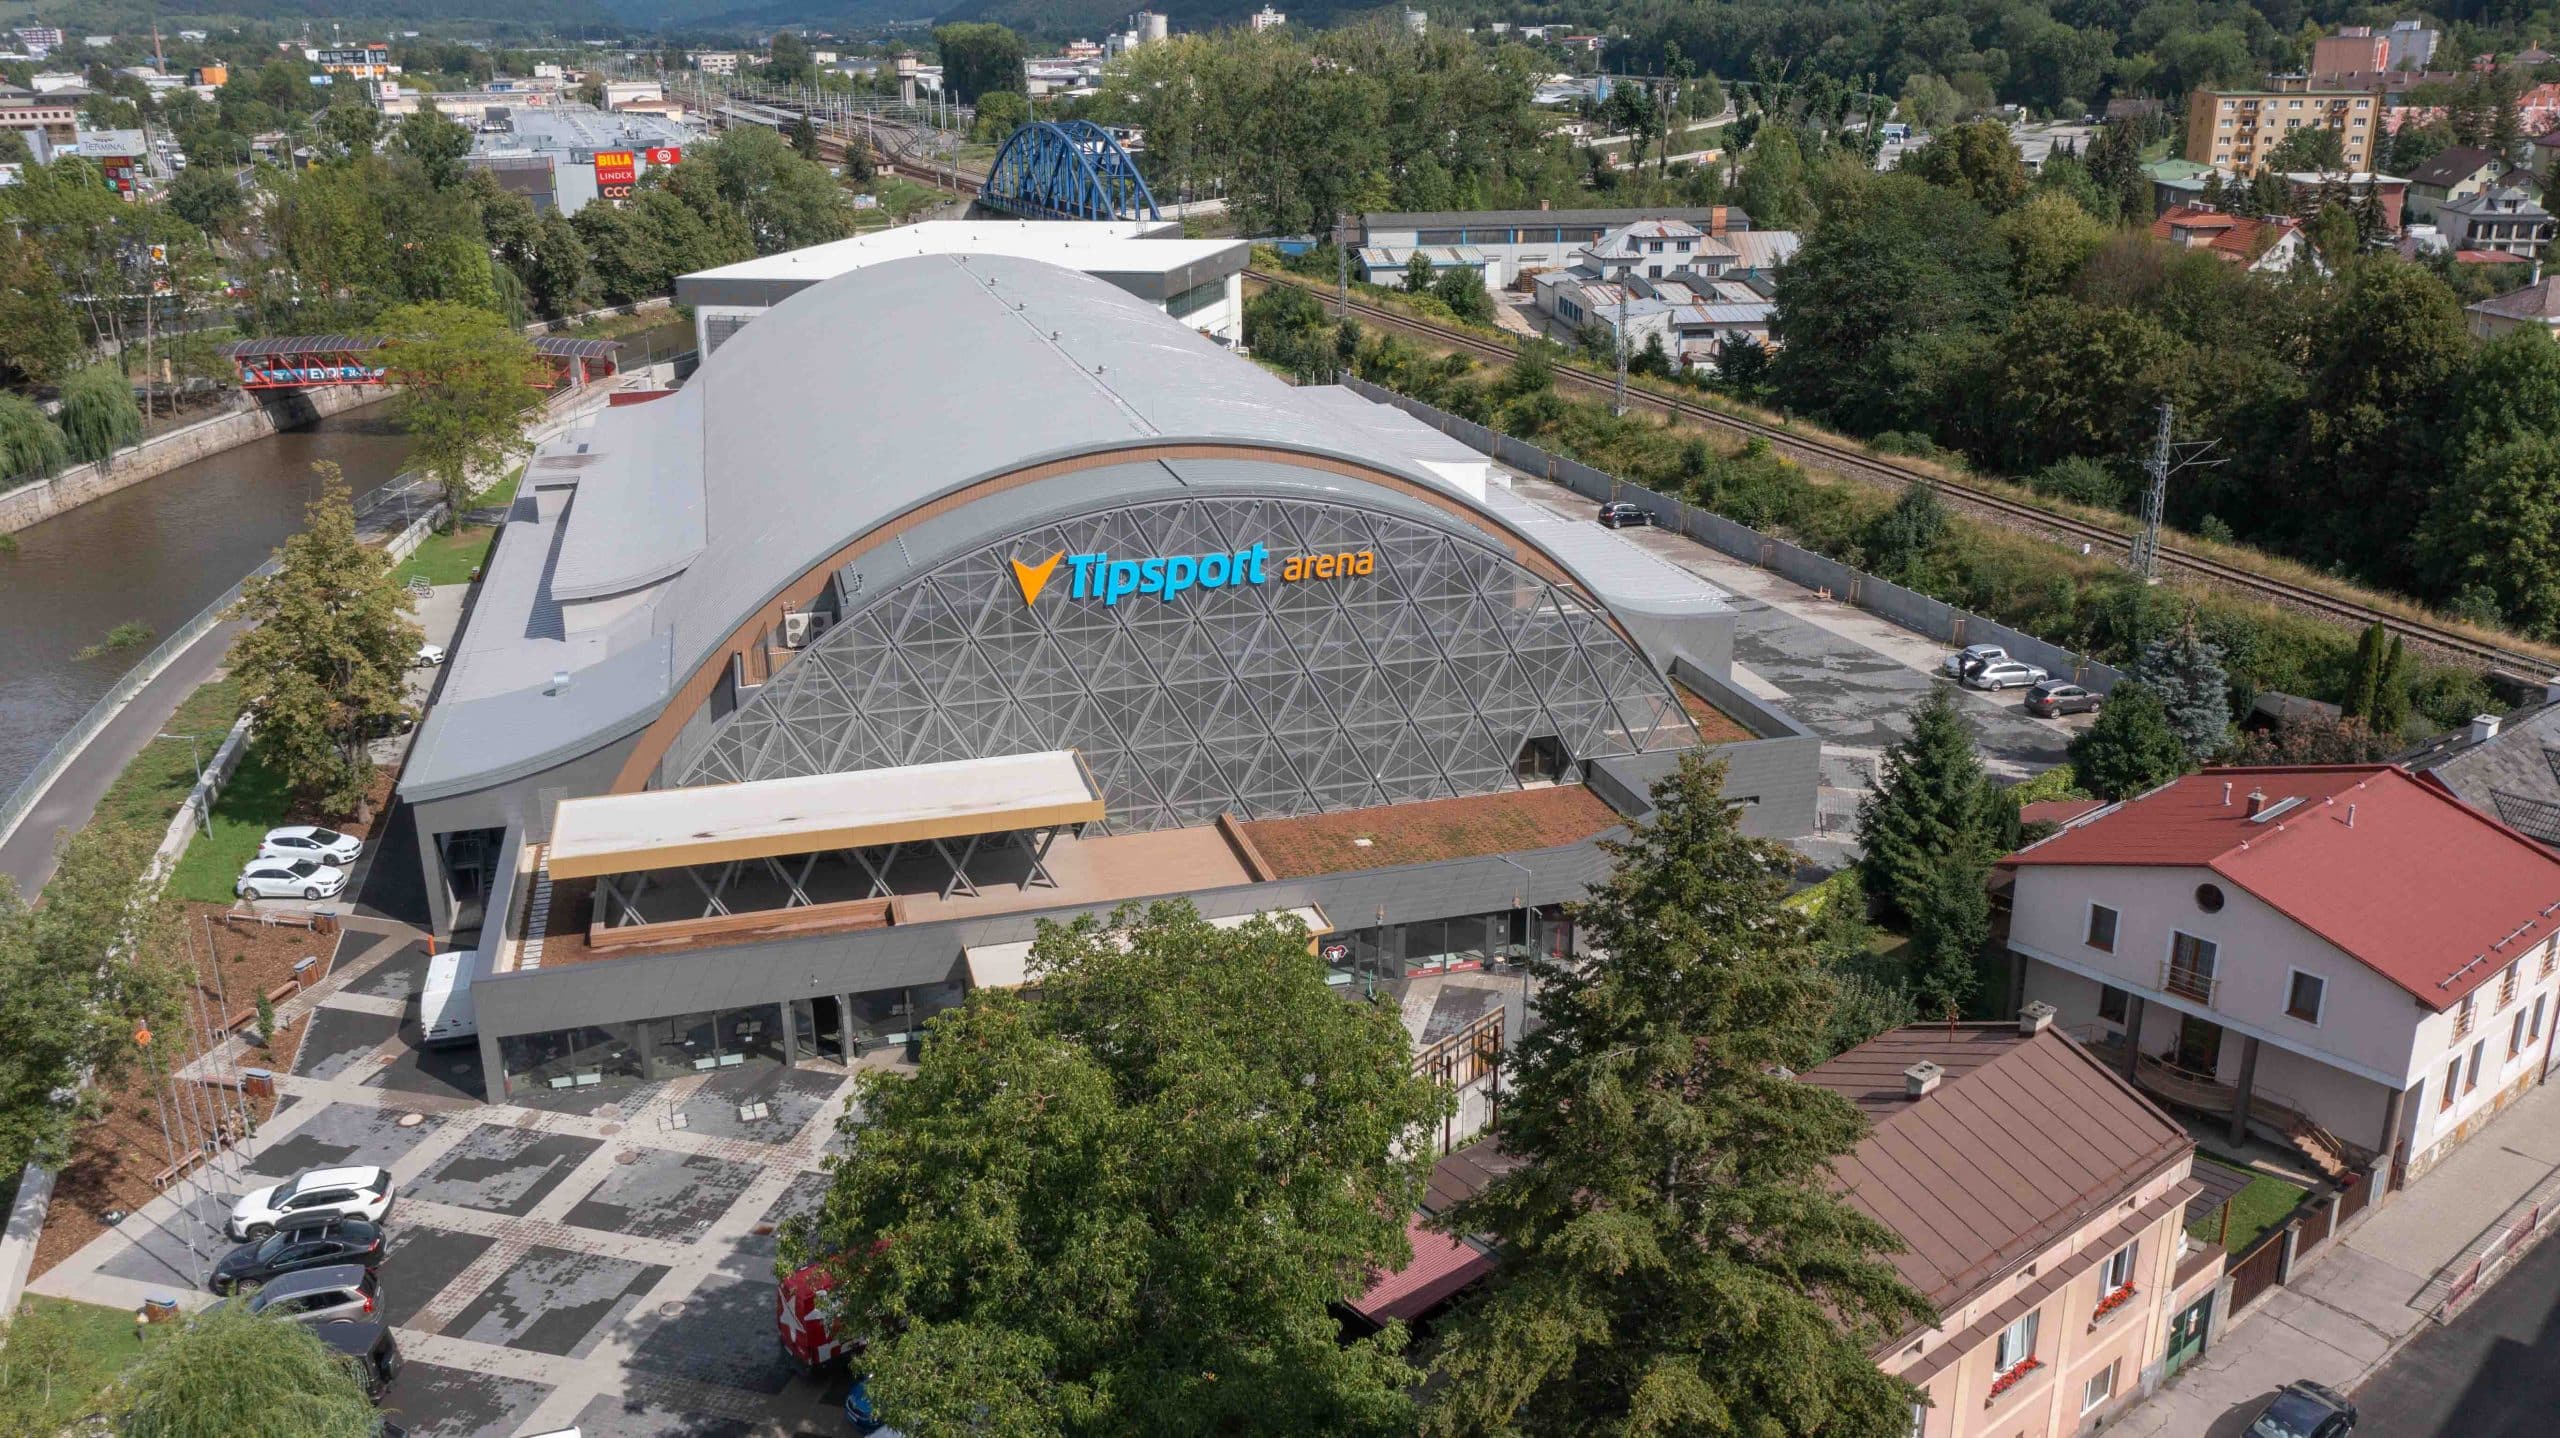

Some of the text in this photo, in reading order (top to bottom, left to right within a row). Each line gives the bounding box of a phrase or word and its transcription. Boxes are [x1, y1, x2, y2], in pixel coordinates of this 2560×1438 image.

[598, 154, 632, 166] BILLA
[600, 172, 632, 180] LINDEX
[604, 187, 631, 197] CCC
[1067, 541, 1374, 605] Tipsport arena
